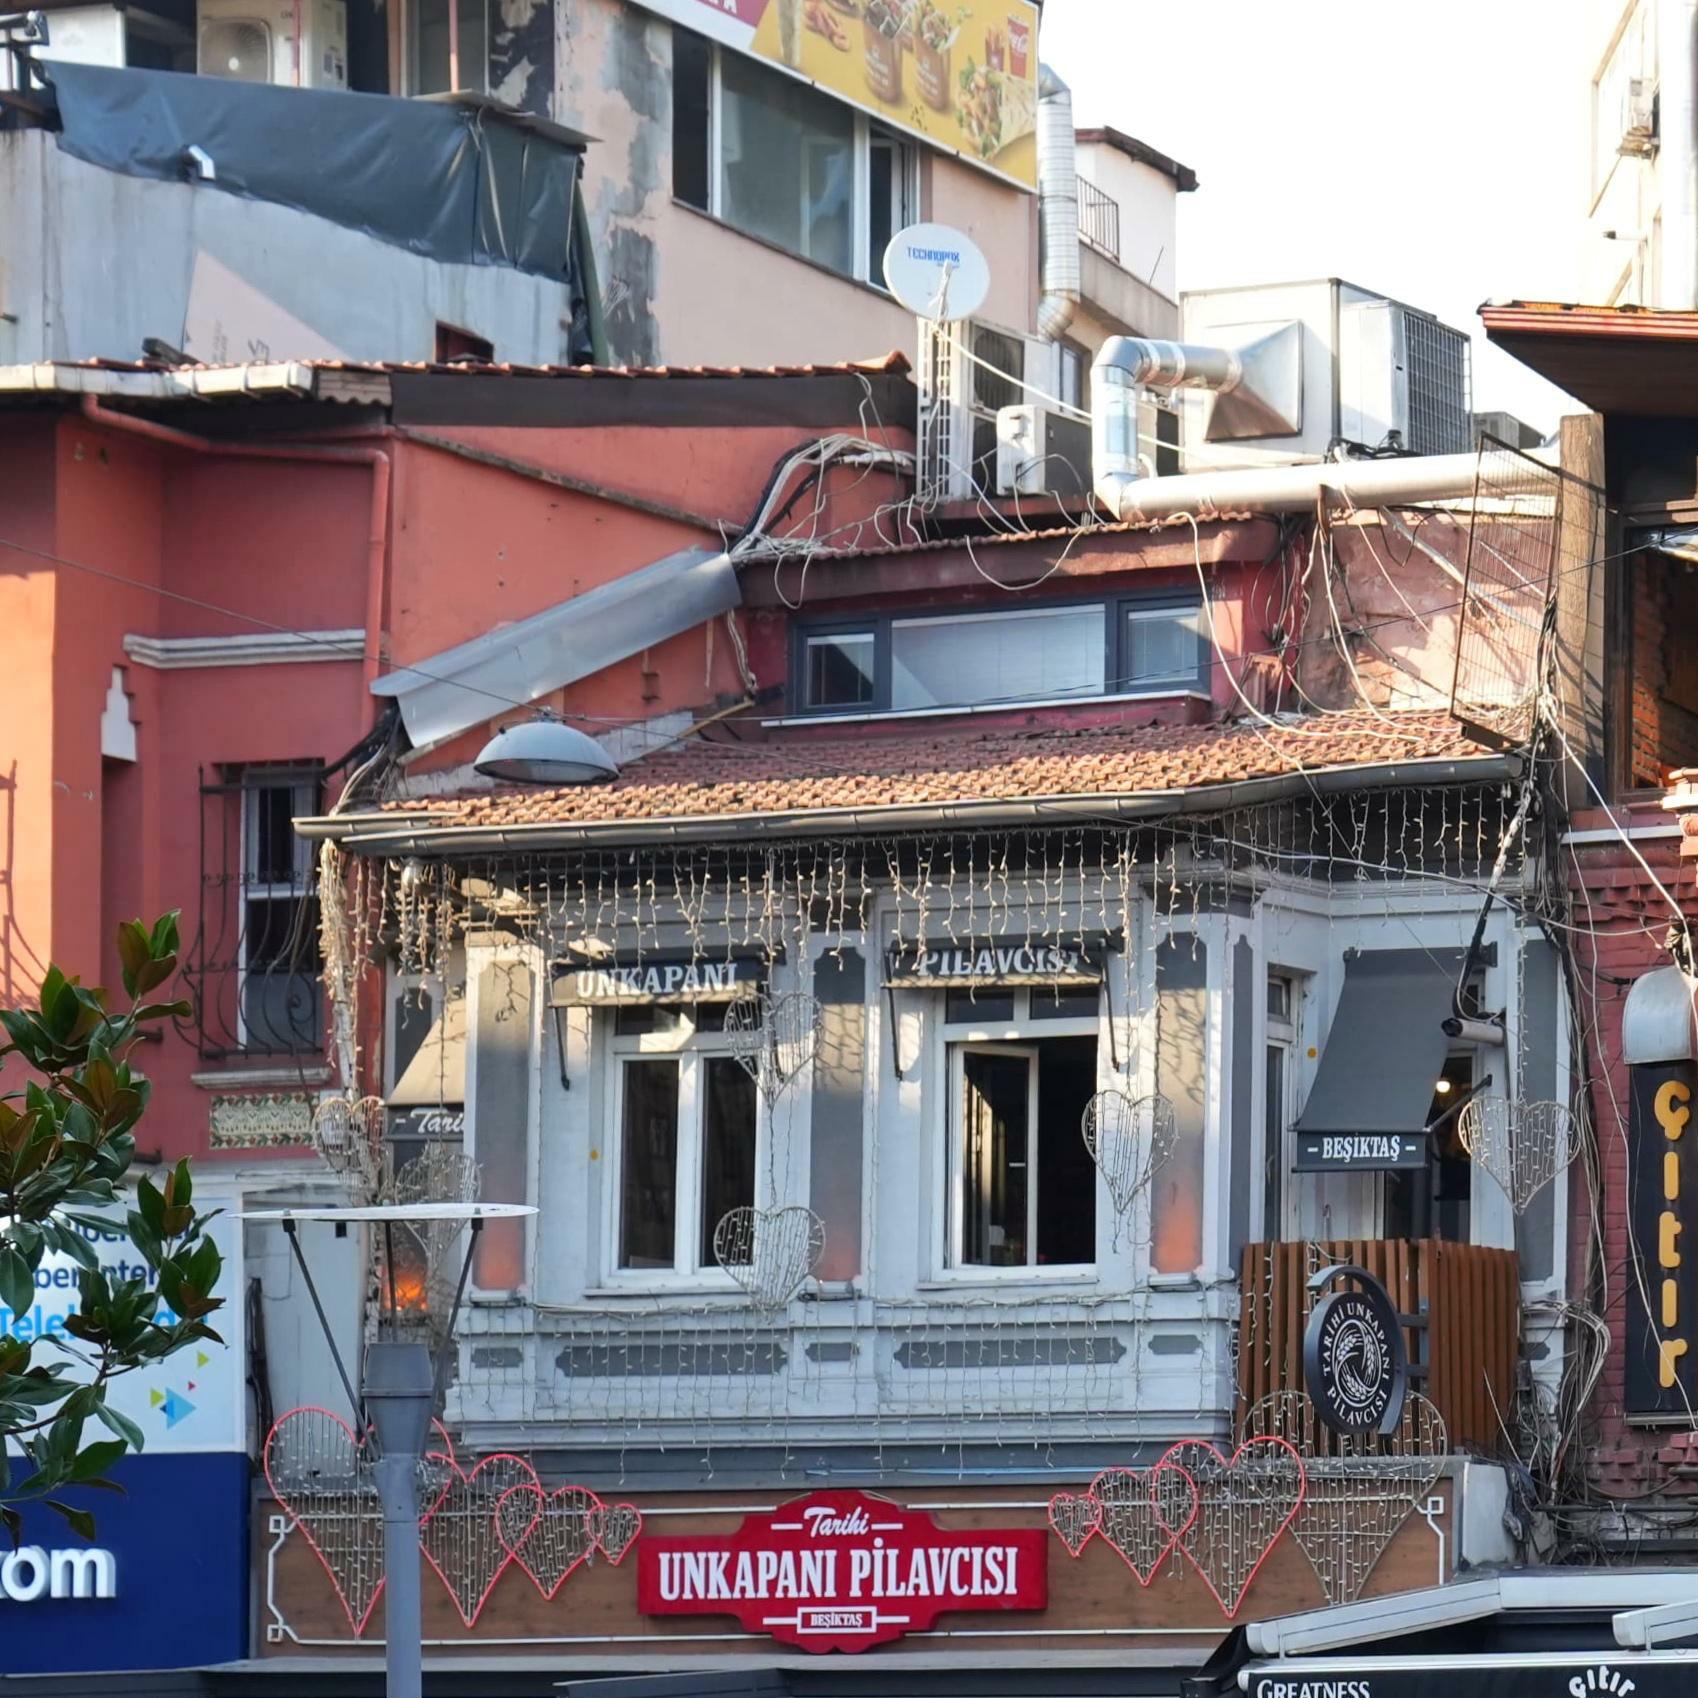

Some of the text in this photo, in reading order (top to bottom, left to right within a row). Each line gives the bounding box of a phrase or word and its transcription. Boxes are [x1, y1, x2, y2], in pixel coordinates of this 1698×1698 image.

[576, 963, 738, 998] UNKAPANI
[410, 1107, 465, 1134] Tari
[1322, 1133, 1401, 1163] BEŞİKTAŞ
[803, 1506, 870, 1538] Tarihi
[658, 1537, 1019, 1600] UNKAPANI PİLAVCISI
[809, 1610, 863, 1629] BEŞİKTAŞ
